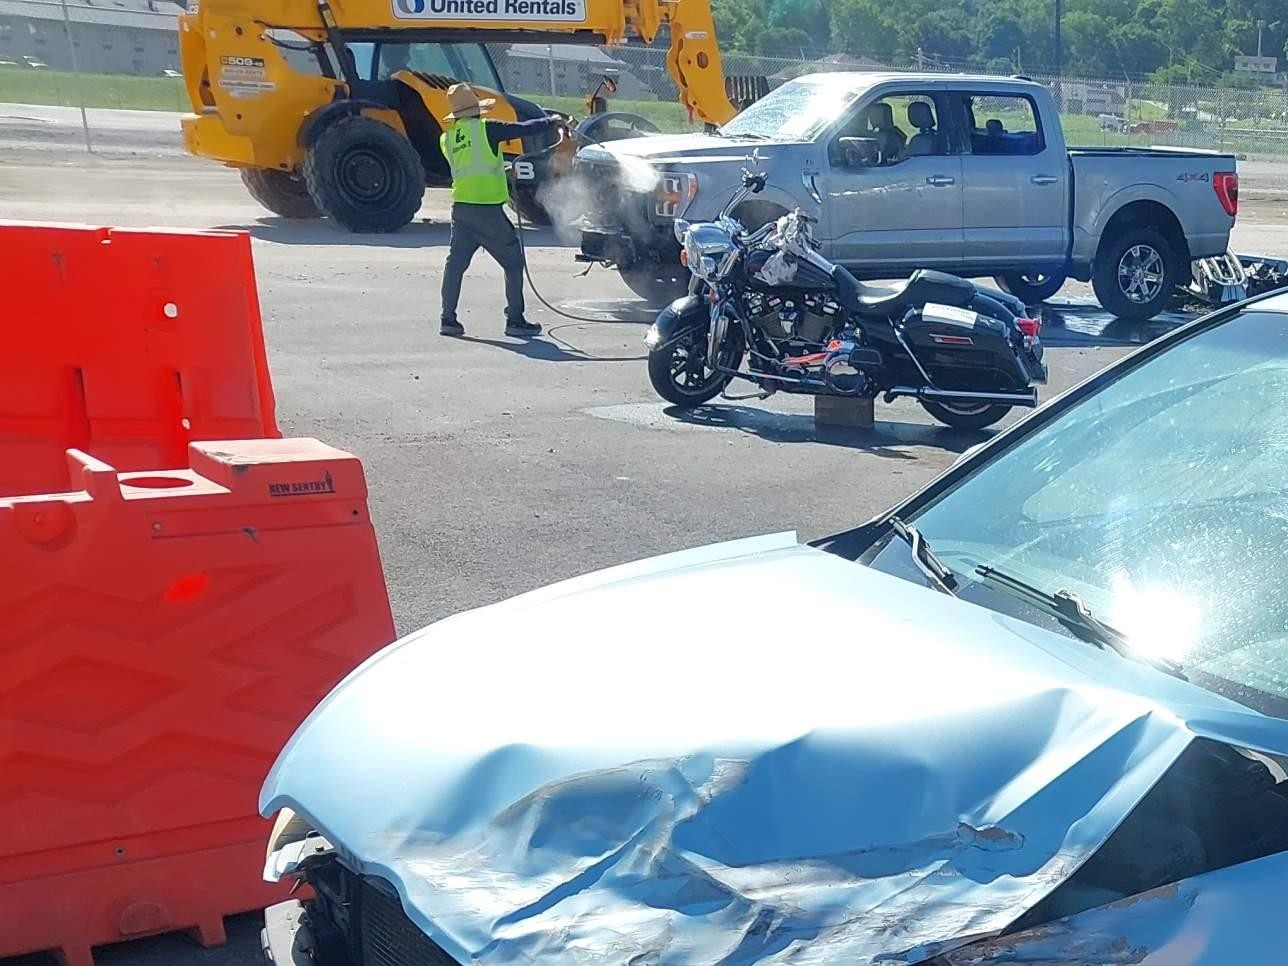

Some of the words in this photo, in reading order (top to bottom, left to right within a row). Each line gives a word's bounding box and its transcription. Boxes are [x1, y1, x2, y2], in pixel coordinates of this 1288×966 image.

[430, 0, 498, 14] United
[504, 0, 576, 15] Rentals
[269, 484, 290, 494] NEW
[291, 481, 327, 492] SENTRY
